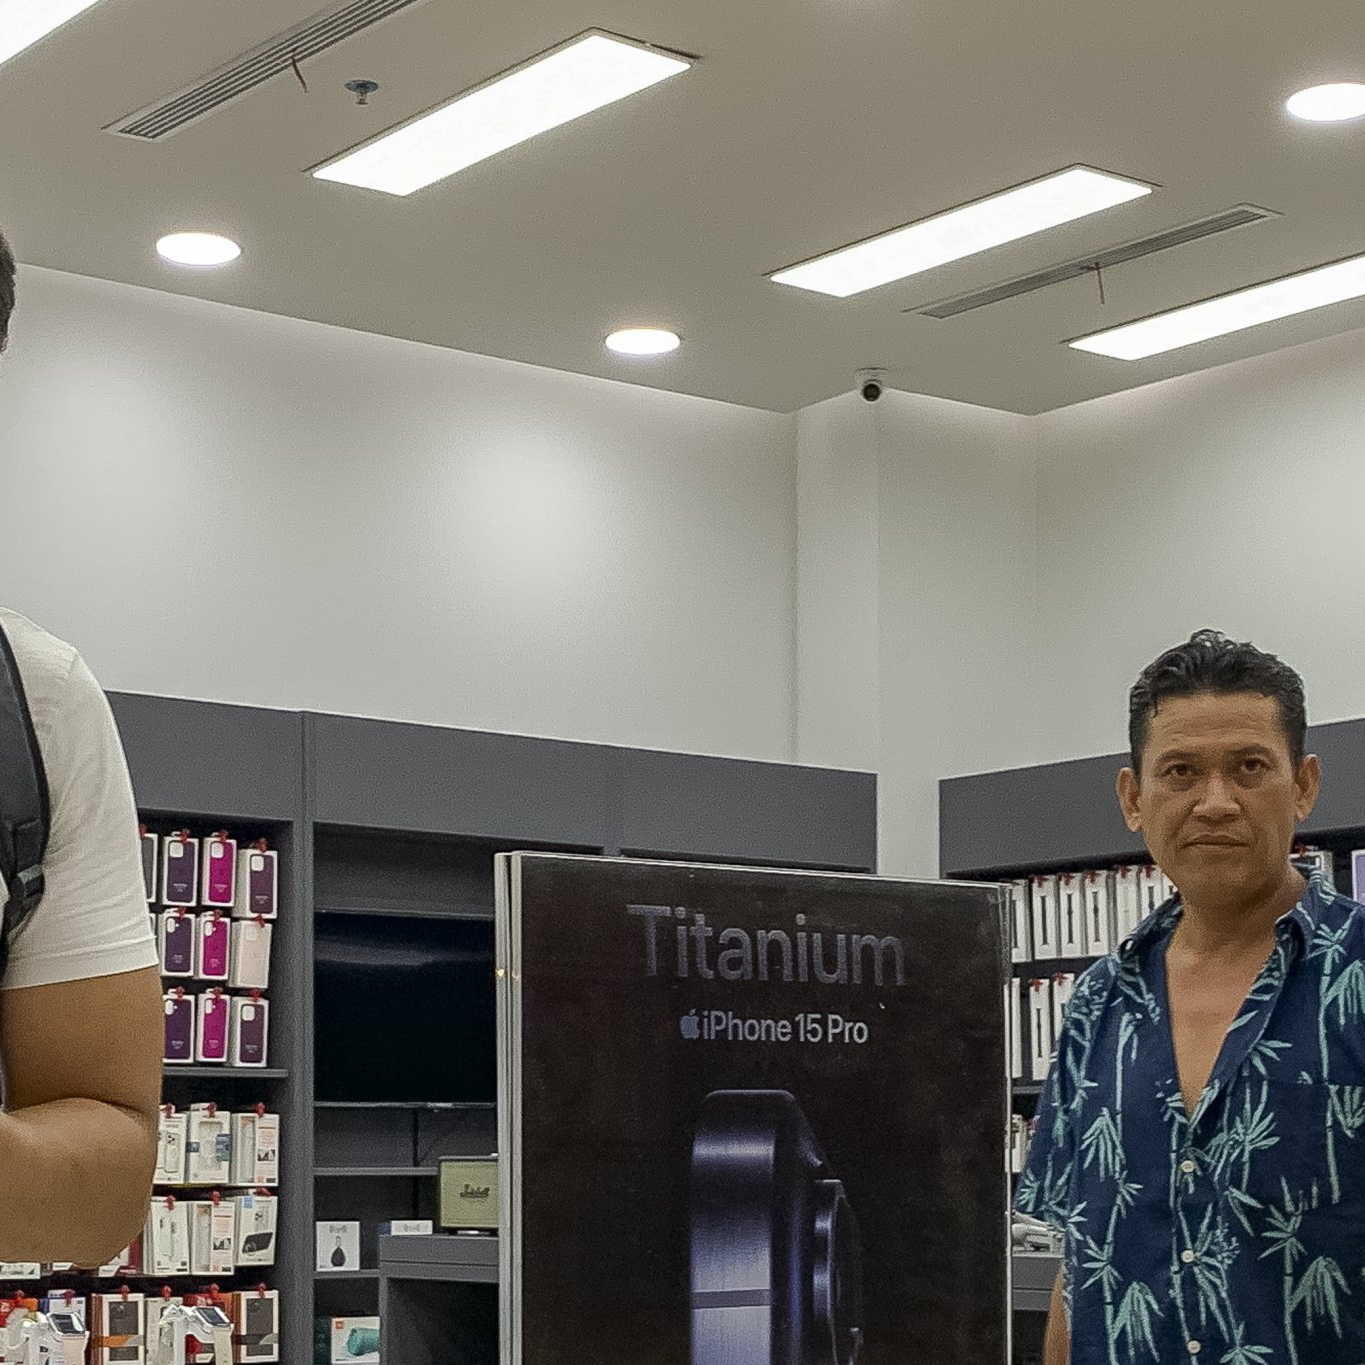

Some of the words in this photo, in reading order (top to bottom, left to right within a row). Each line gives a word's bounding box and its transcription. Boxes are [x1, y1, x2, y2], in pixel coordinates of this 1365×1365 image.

[626, 903, 906, 986] Titanium
[702, 1010, 792, 1042] iPhone
[794, 1013, 822, 1043] 15
[827, 1013, 869, 1044] Pro
